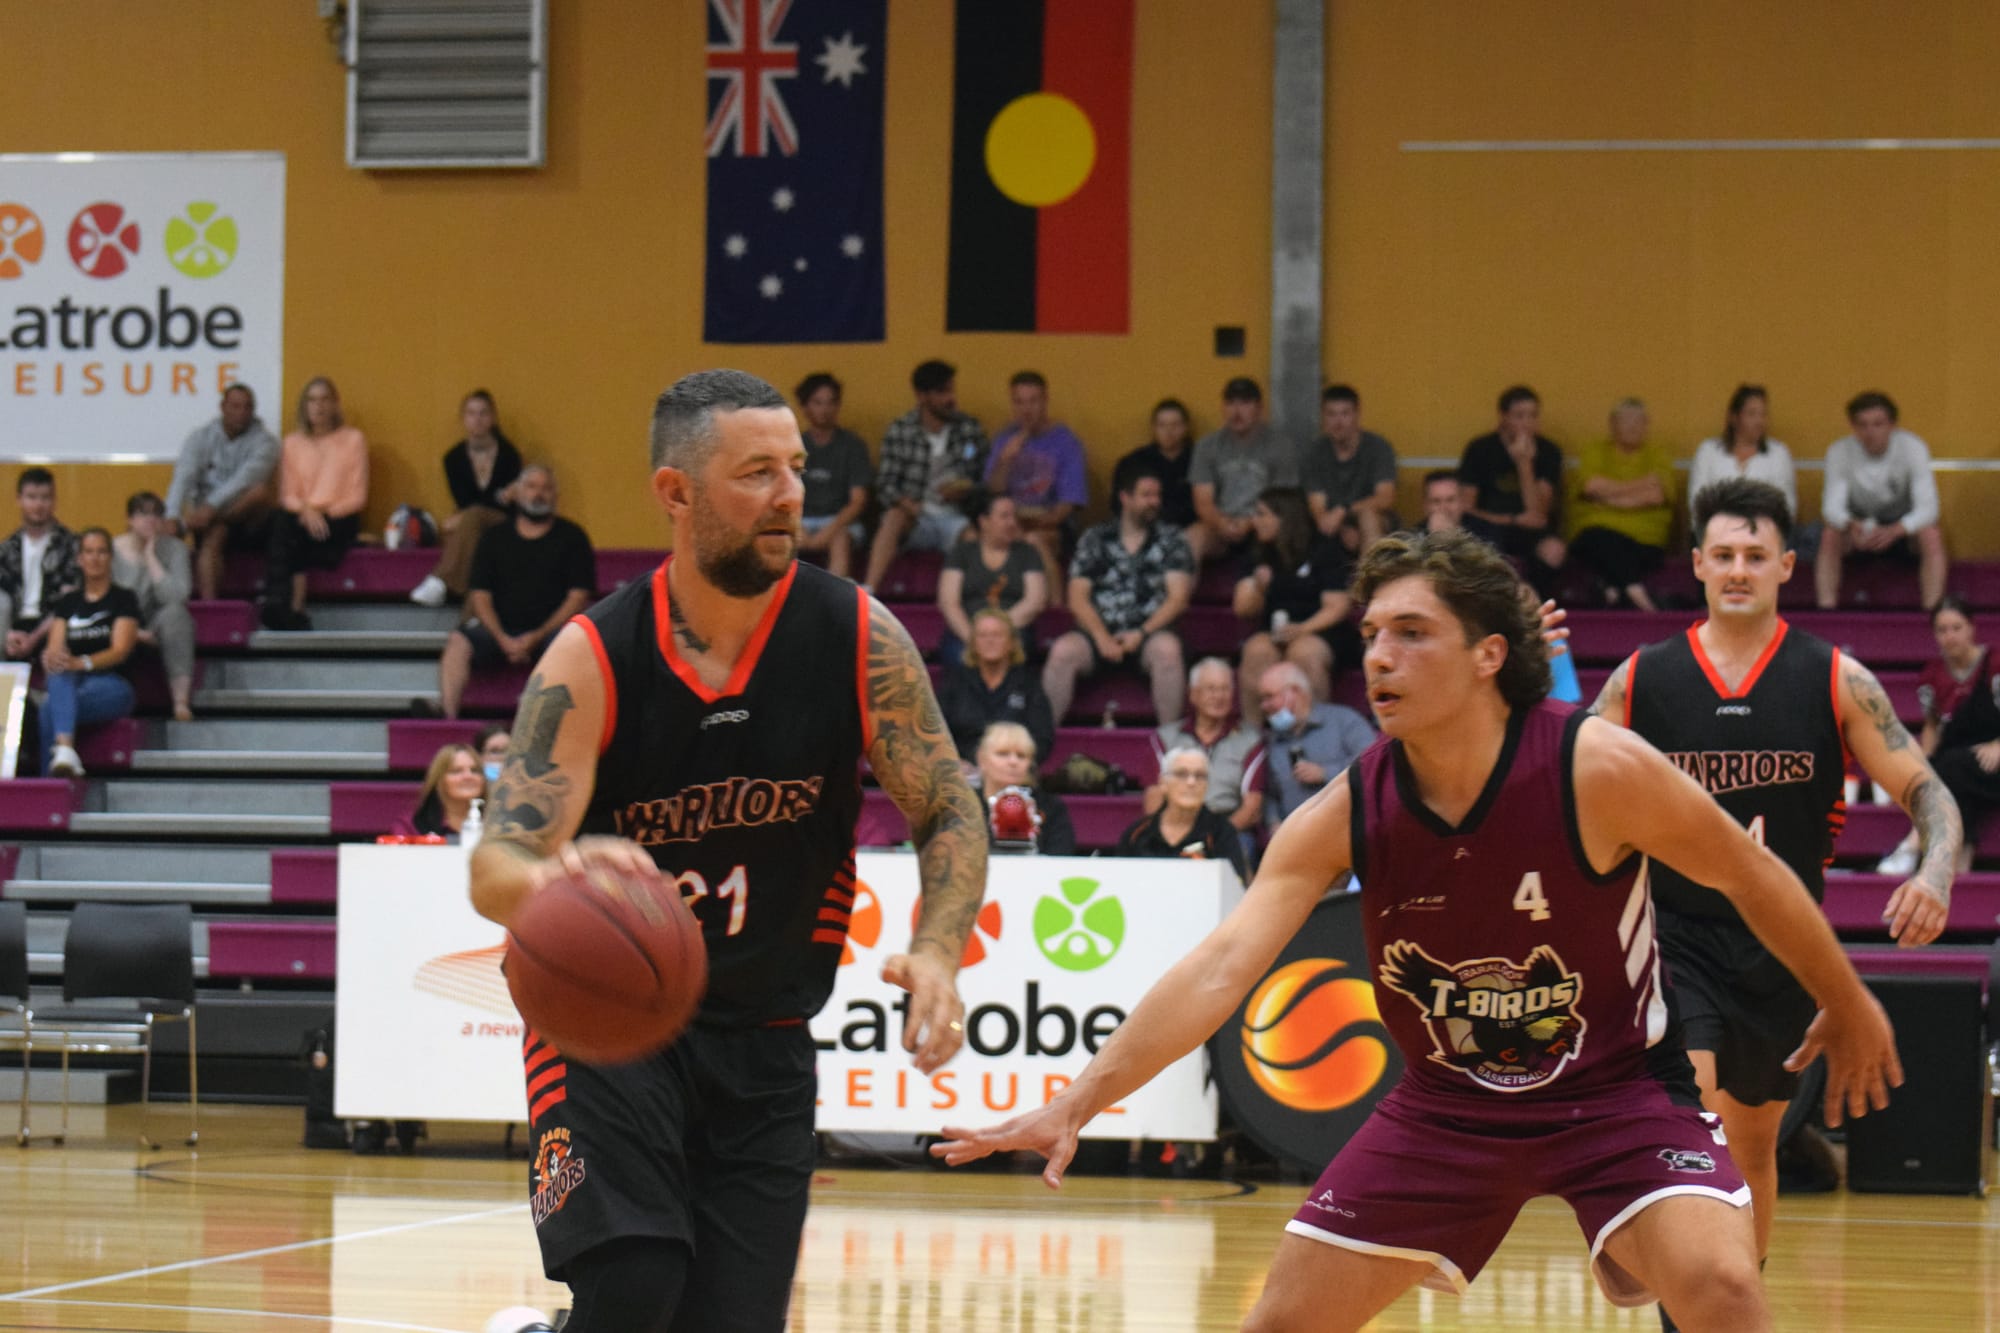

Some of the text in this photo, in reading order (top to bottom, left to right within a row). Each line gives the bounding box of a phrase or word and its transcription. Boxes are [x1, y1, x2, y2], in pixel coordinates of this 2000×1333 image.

[0, 286, 243, 350] atrobe
[14, 362, 240, 396] EISURE
[1512, 871, 1551, 921] 4
[815, 980, 1127, 1057] aobe
[1429, 978, 1575, 1021] T-BIRDS
[461, 1021, 475, 1036] a
[816, 1069, 1126, 1114] EISUR
